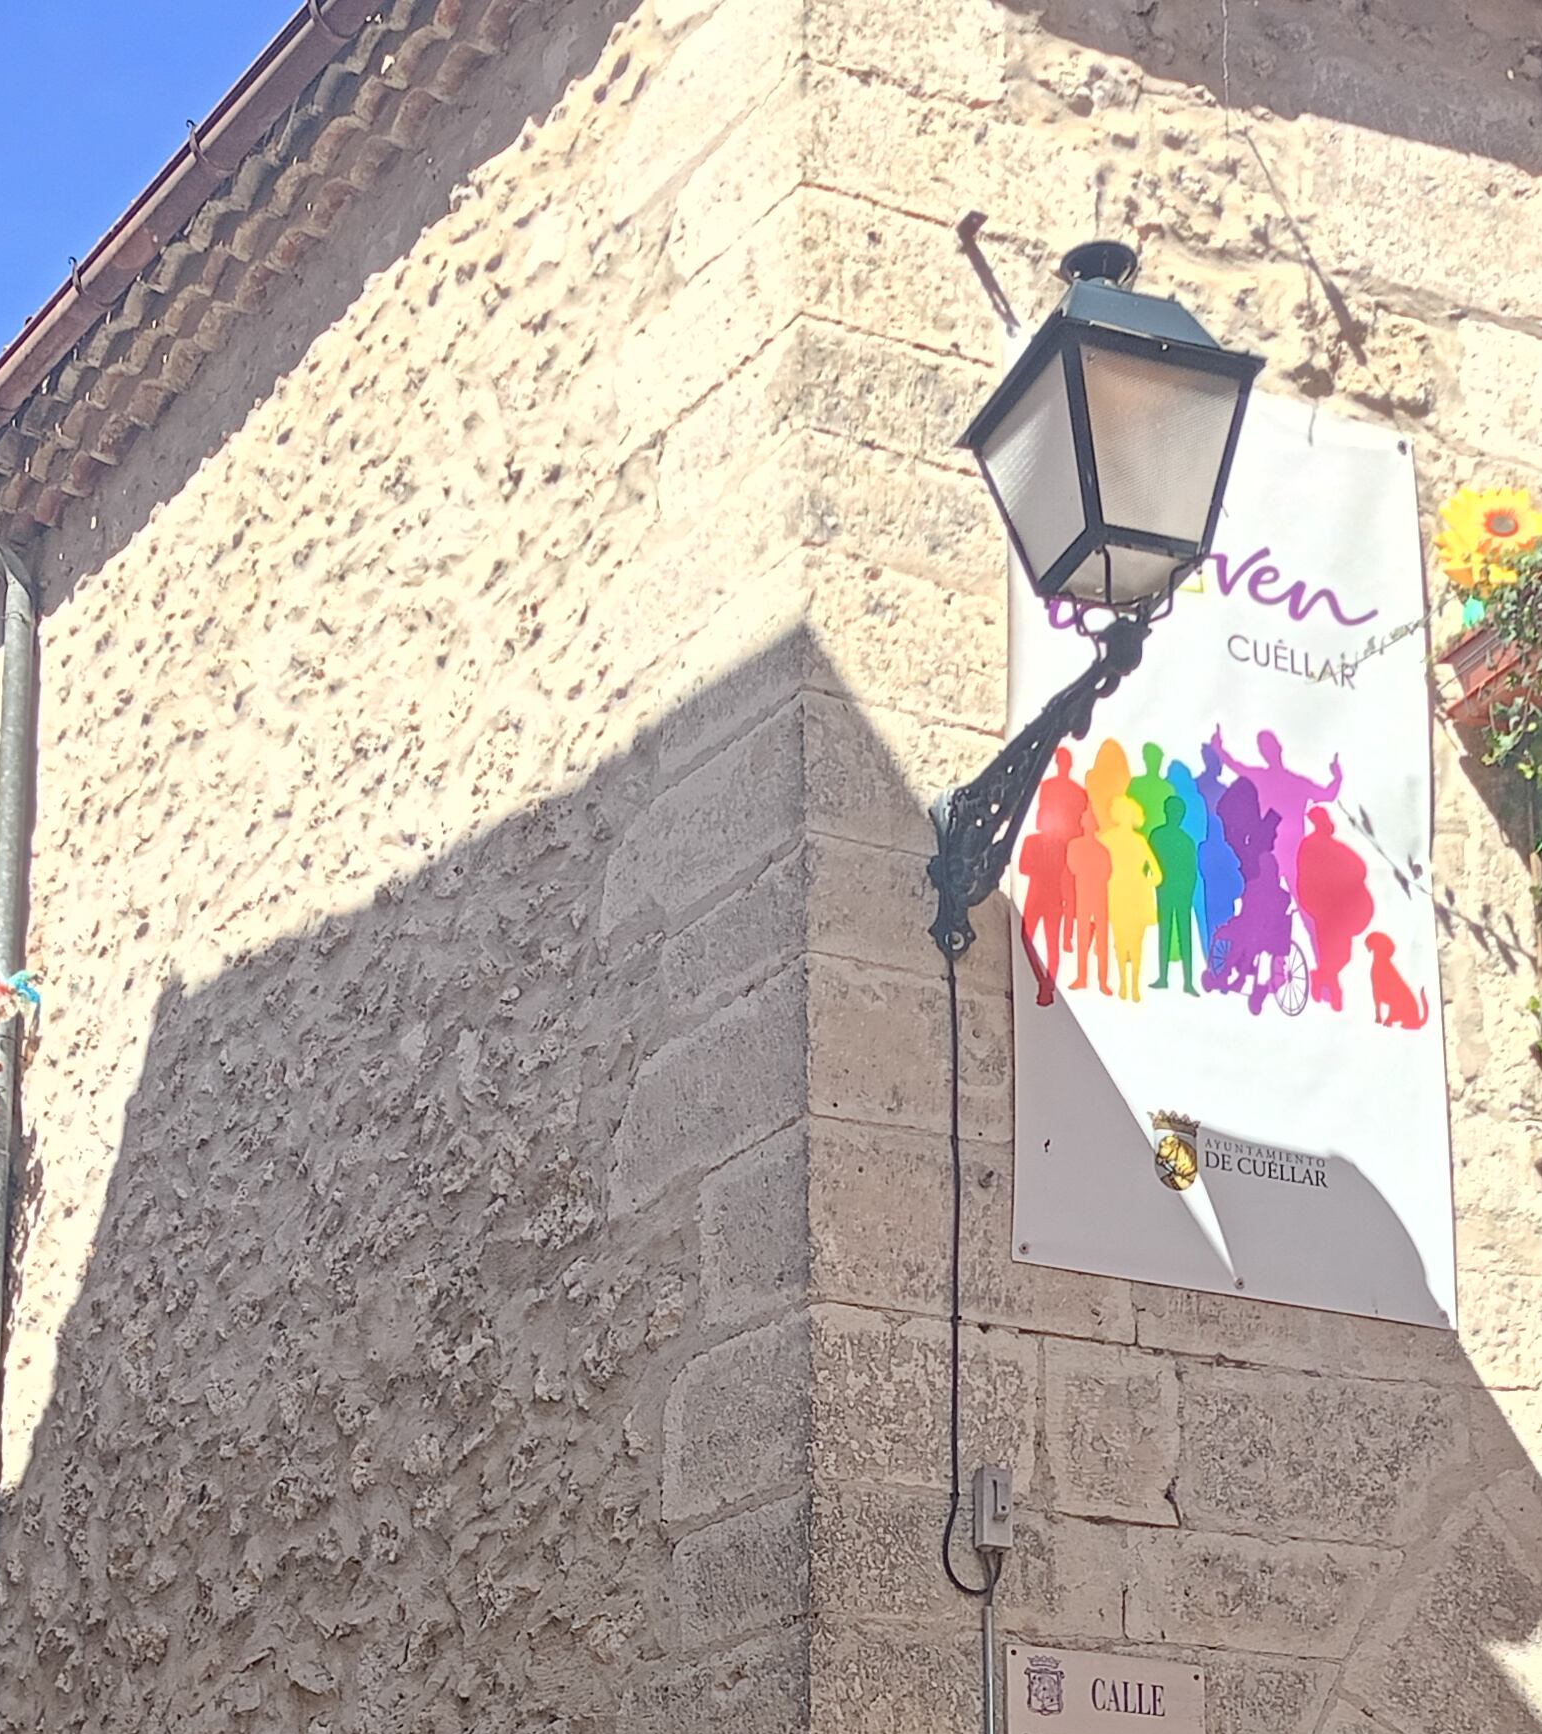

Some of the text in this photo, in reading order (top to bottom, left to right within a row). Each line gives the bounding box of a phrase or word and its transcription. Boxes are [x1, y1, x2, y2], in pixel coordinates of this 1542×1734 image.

[1227, 634, 1357, 690] CUÉLLAR
[1205, 1139, 1326, 1168] AYUNTAMIENTO
[1205, 1151, 1329, 1188] DE CUÉLLAR
[1091, 1678, 1165, 1717] CALLE
